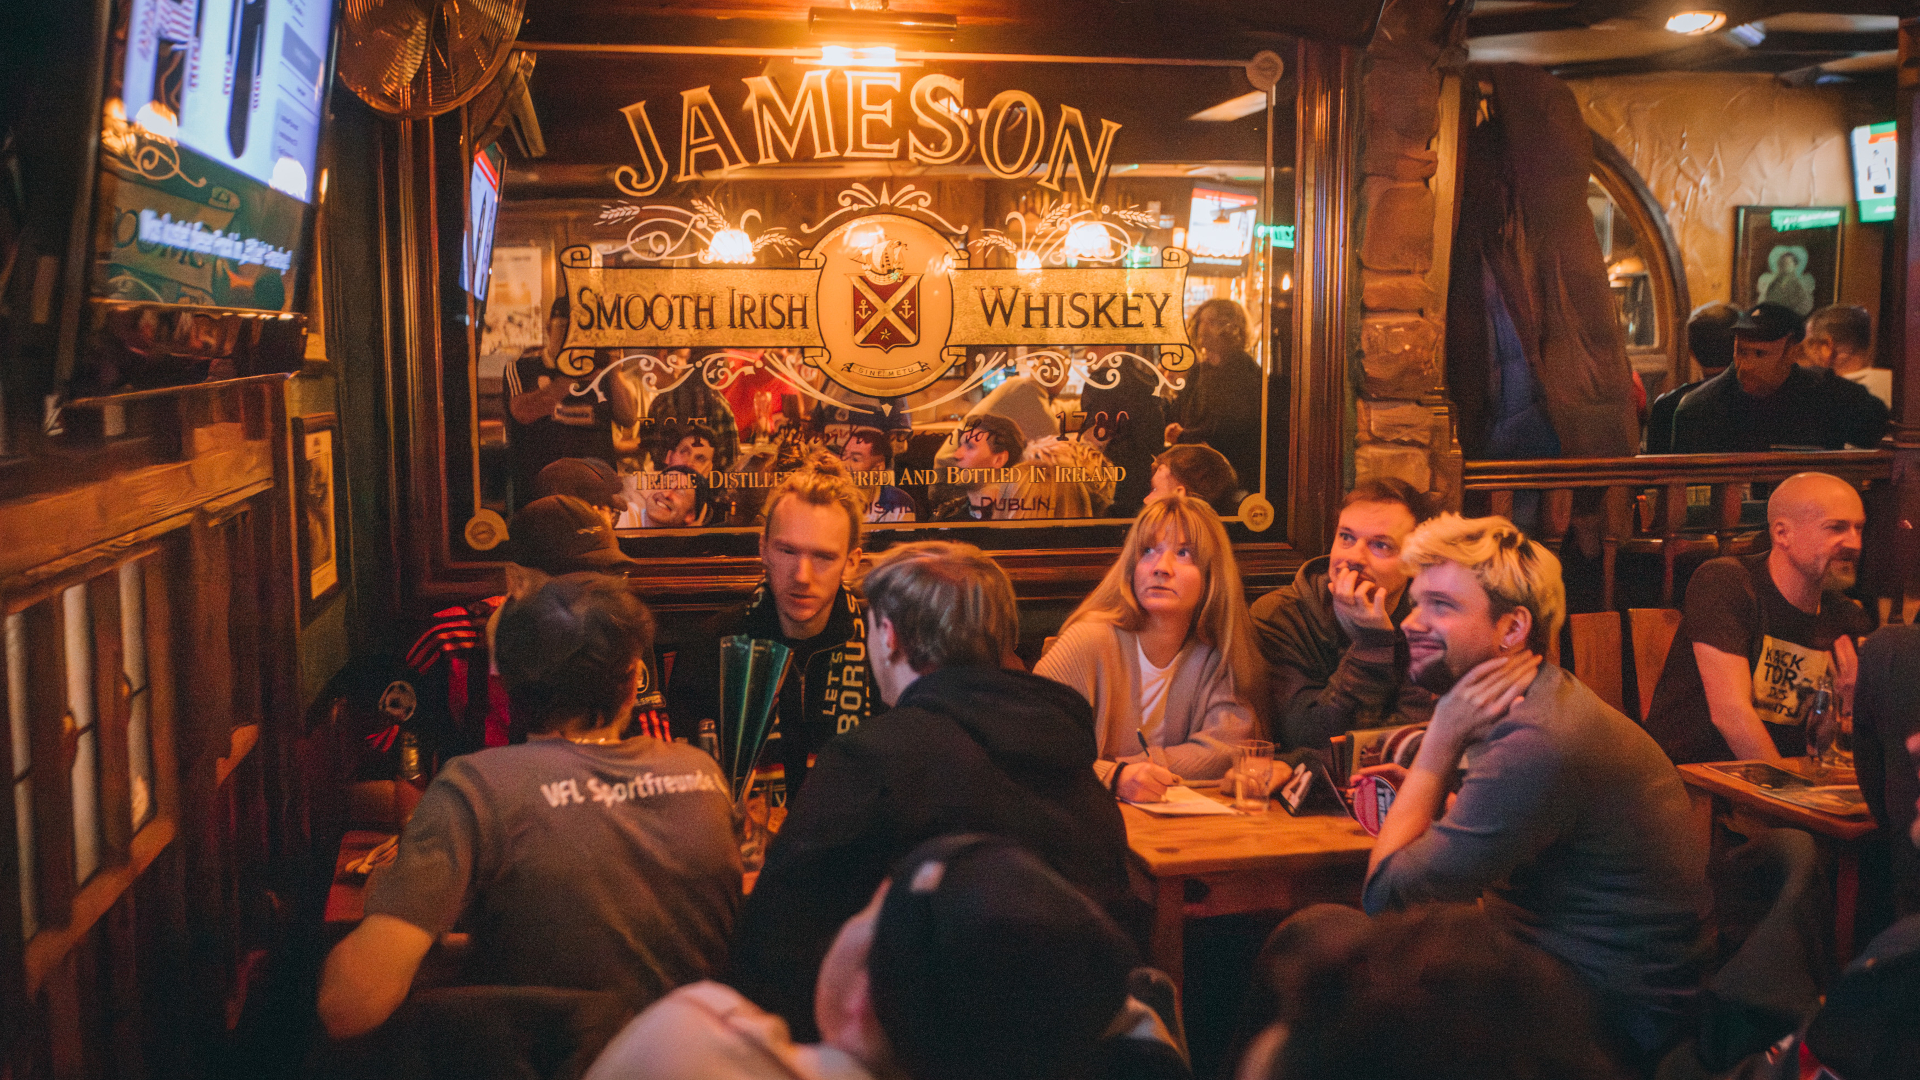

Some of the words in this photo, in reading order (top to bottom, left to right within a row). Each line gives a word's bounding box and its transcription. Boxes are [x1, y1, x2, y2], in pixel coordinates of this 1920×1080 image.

[615, 68, 1123, 204] JAMESON
[577, 286, 716, 331] SMOOTH
[726, 286, 810, 331] IRISH
[974, 286, 1172, 329] WHISKEY
[858, 367, 883, 377] SINE
[888, 367, 914, 377] METU
[898, 467, 938, 486] AND
[946, 465, 1023, 485] BOTTLED
[1029, 465, 1047, 484] IN
[1054, 465, 1128, 484] IRELAND
[980, 495, 1051, 512] DUBLIN
